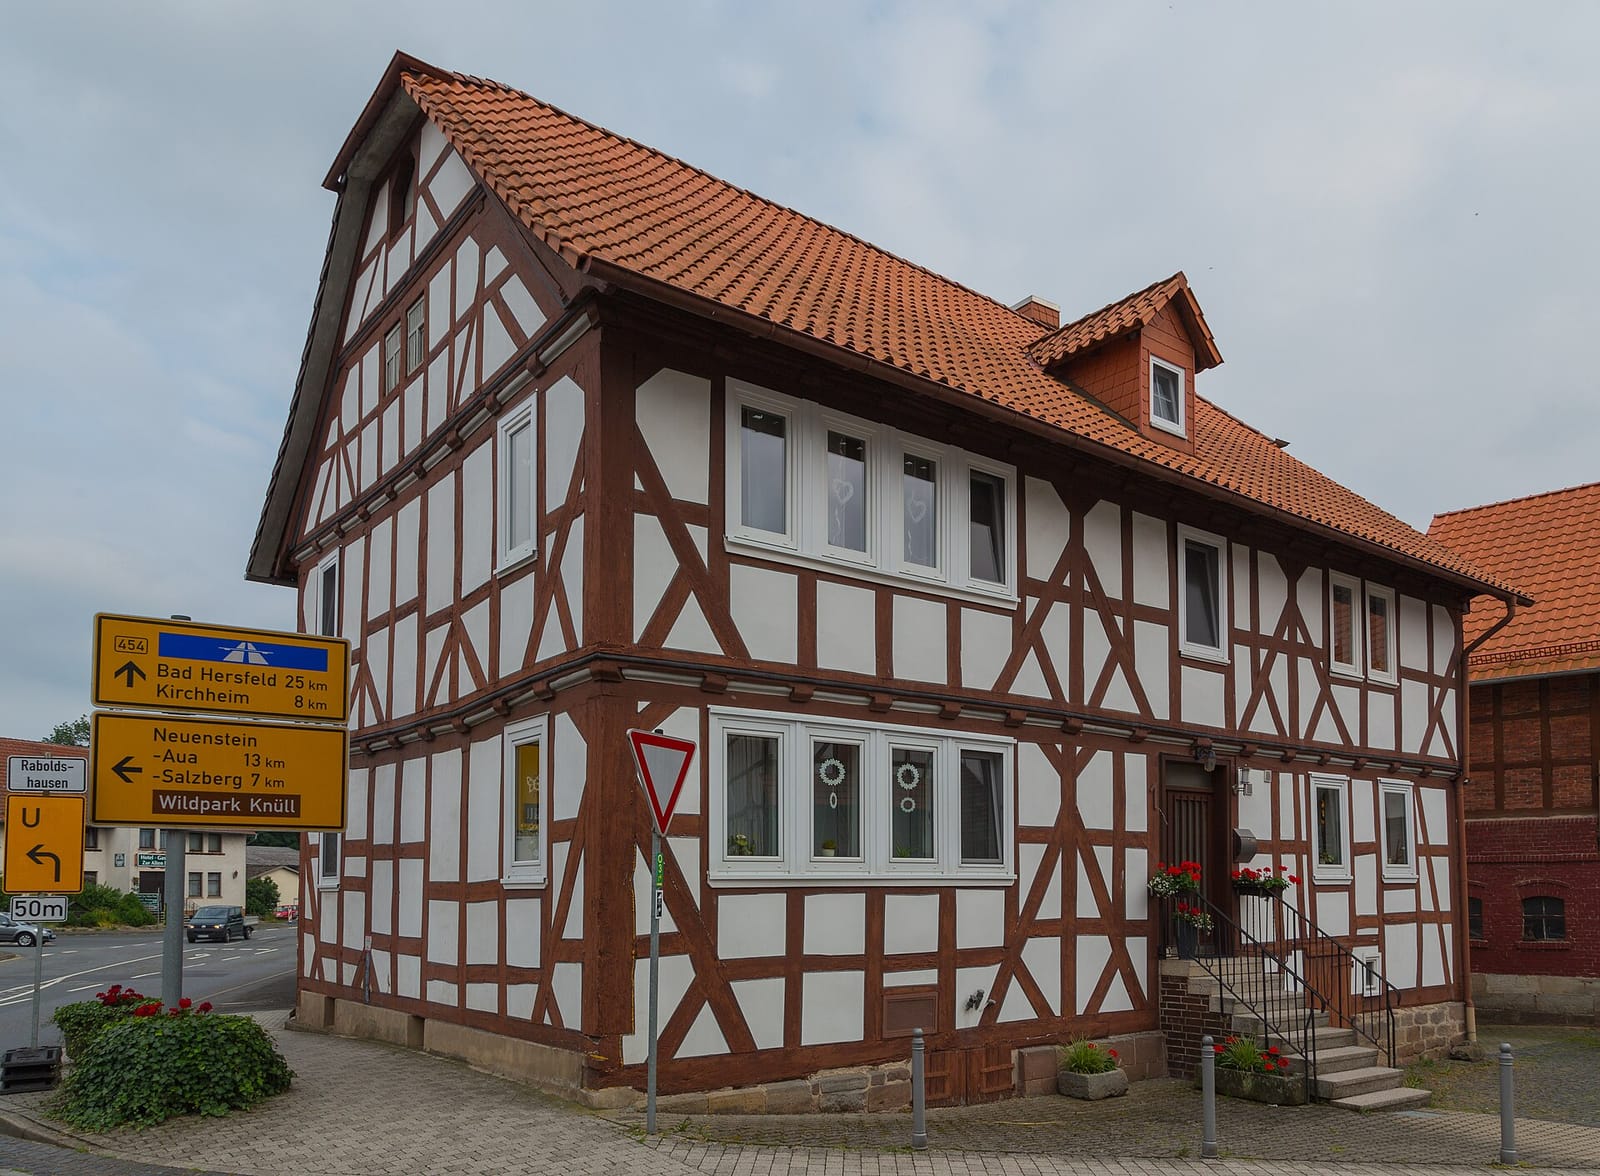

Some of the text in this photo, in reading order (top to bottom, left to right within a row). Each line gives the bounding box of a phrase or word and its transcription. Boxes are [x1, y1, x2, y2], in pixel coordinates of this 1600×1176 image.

[118, 638, 144, 652] 454
[158, 664, 328, 692] Bad Hersfeld 25 km
[157, 684, 328, 710] Kirchheim 8 km
[154, 728, 257, 747] Neuenstein
[22, 760, 74, 772] Rabolds-
[153, 750, 285, 768] -Aua 13 km
[27, 776, 68, 788] hausen
[153, 770, 284, 790] -Salzberg 7 km
[159, 794, 296, 814] Wildpark Knüll
[22, 808, 40, 828] U
[15, 900, 63, 918] 50m
